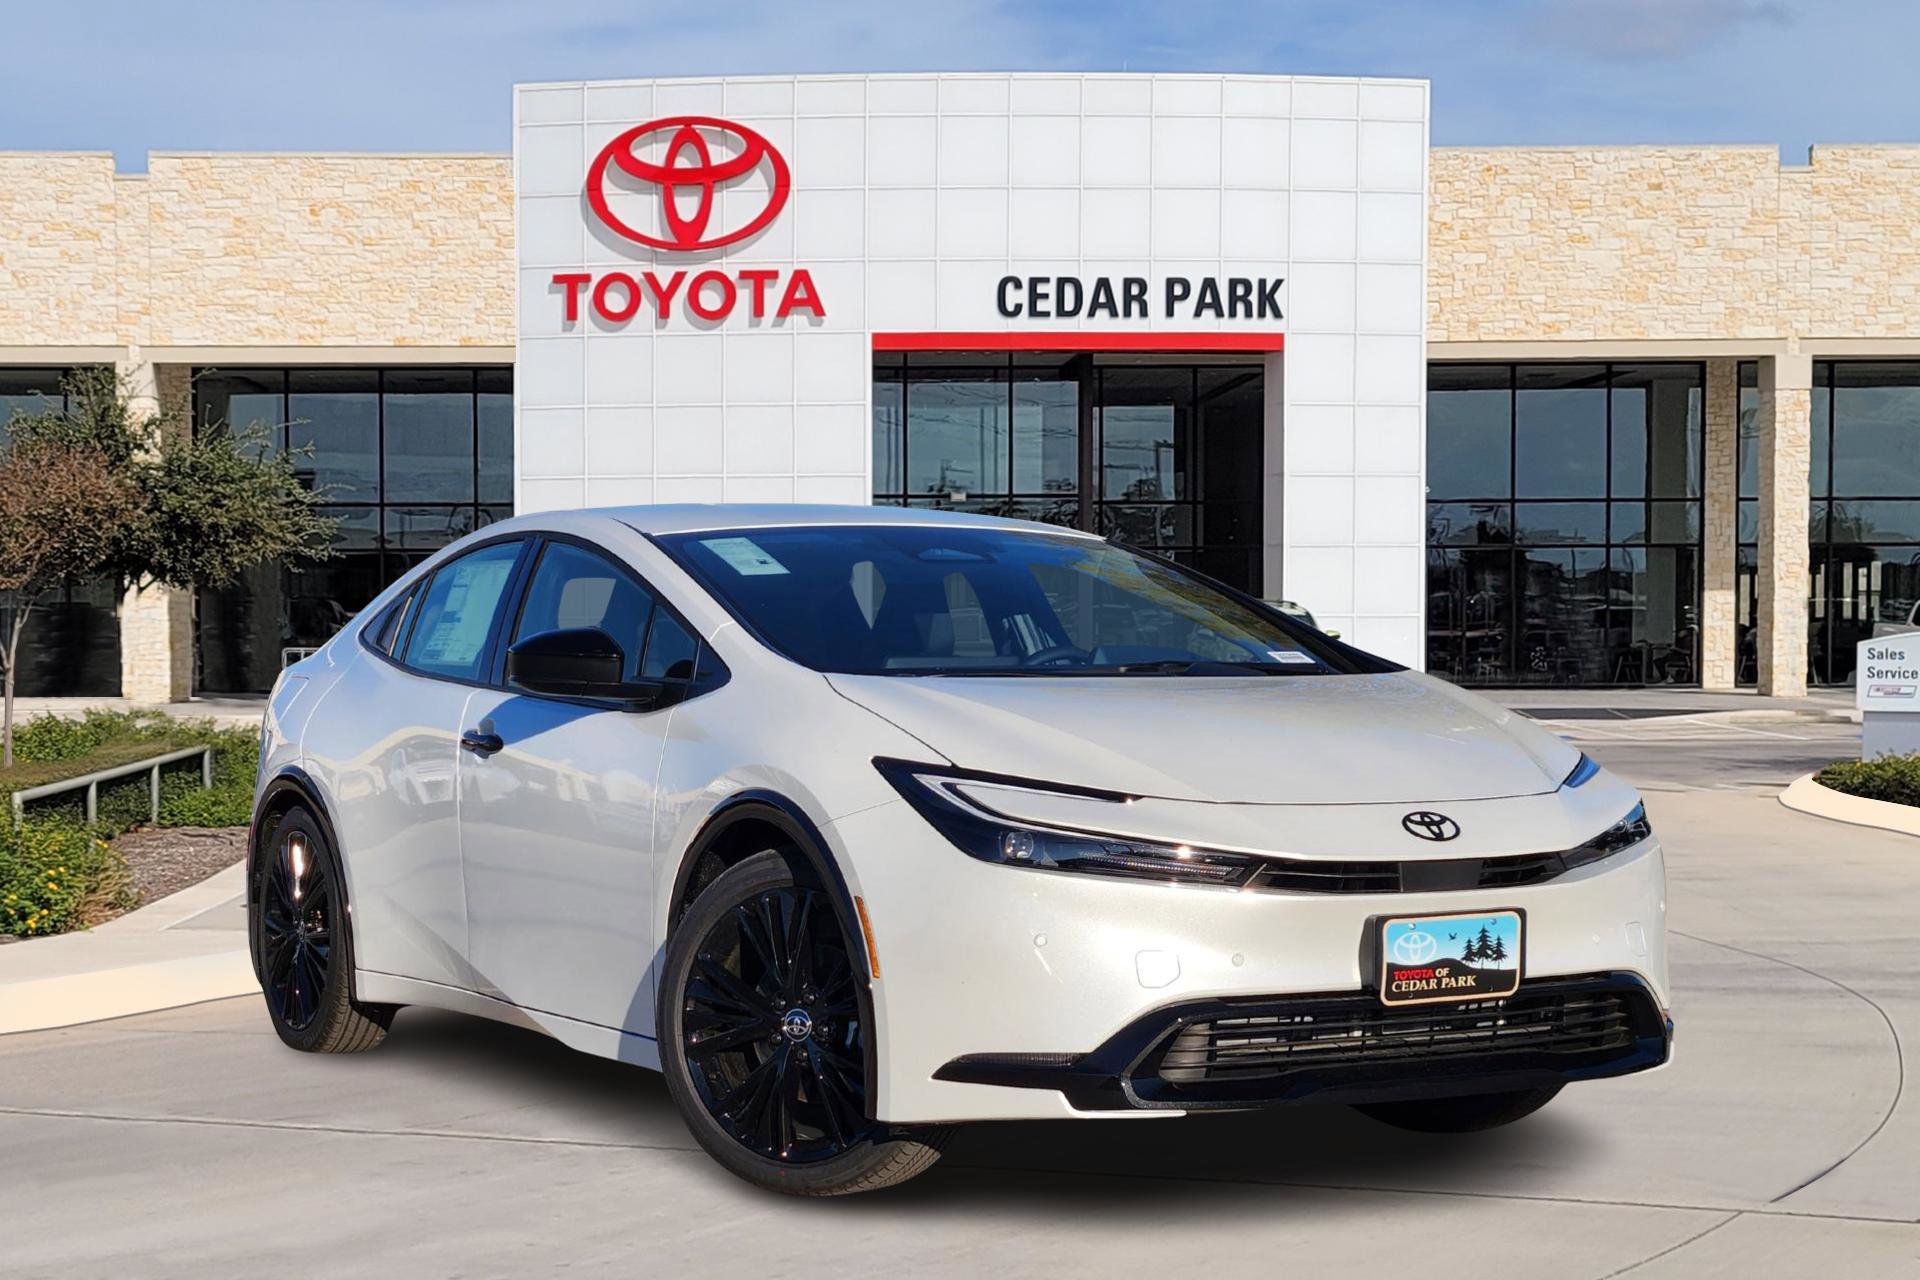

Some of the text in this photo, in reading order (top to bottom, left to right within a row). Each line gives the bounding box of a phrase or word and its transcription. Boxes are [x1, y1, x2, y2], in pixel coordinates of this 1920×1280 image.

[552, 269, 826, 322] TOYOTA
[996, 275, 1285, 319] CEDAR PARK
[1866, 647, 1905, 660] Sales
[1866, 666, 1919, 680] Service
[1393, 967, 1450, 980] TOYOTA OF
[1391, 975, 1477, 992] CEDAR PARK
